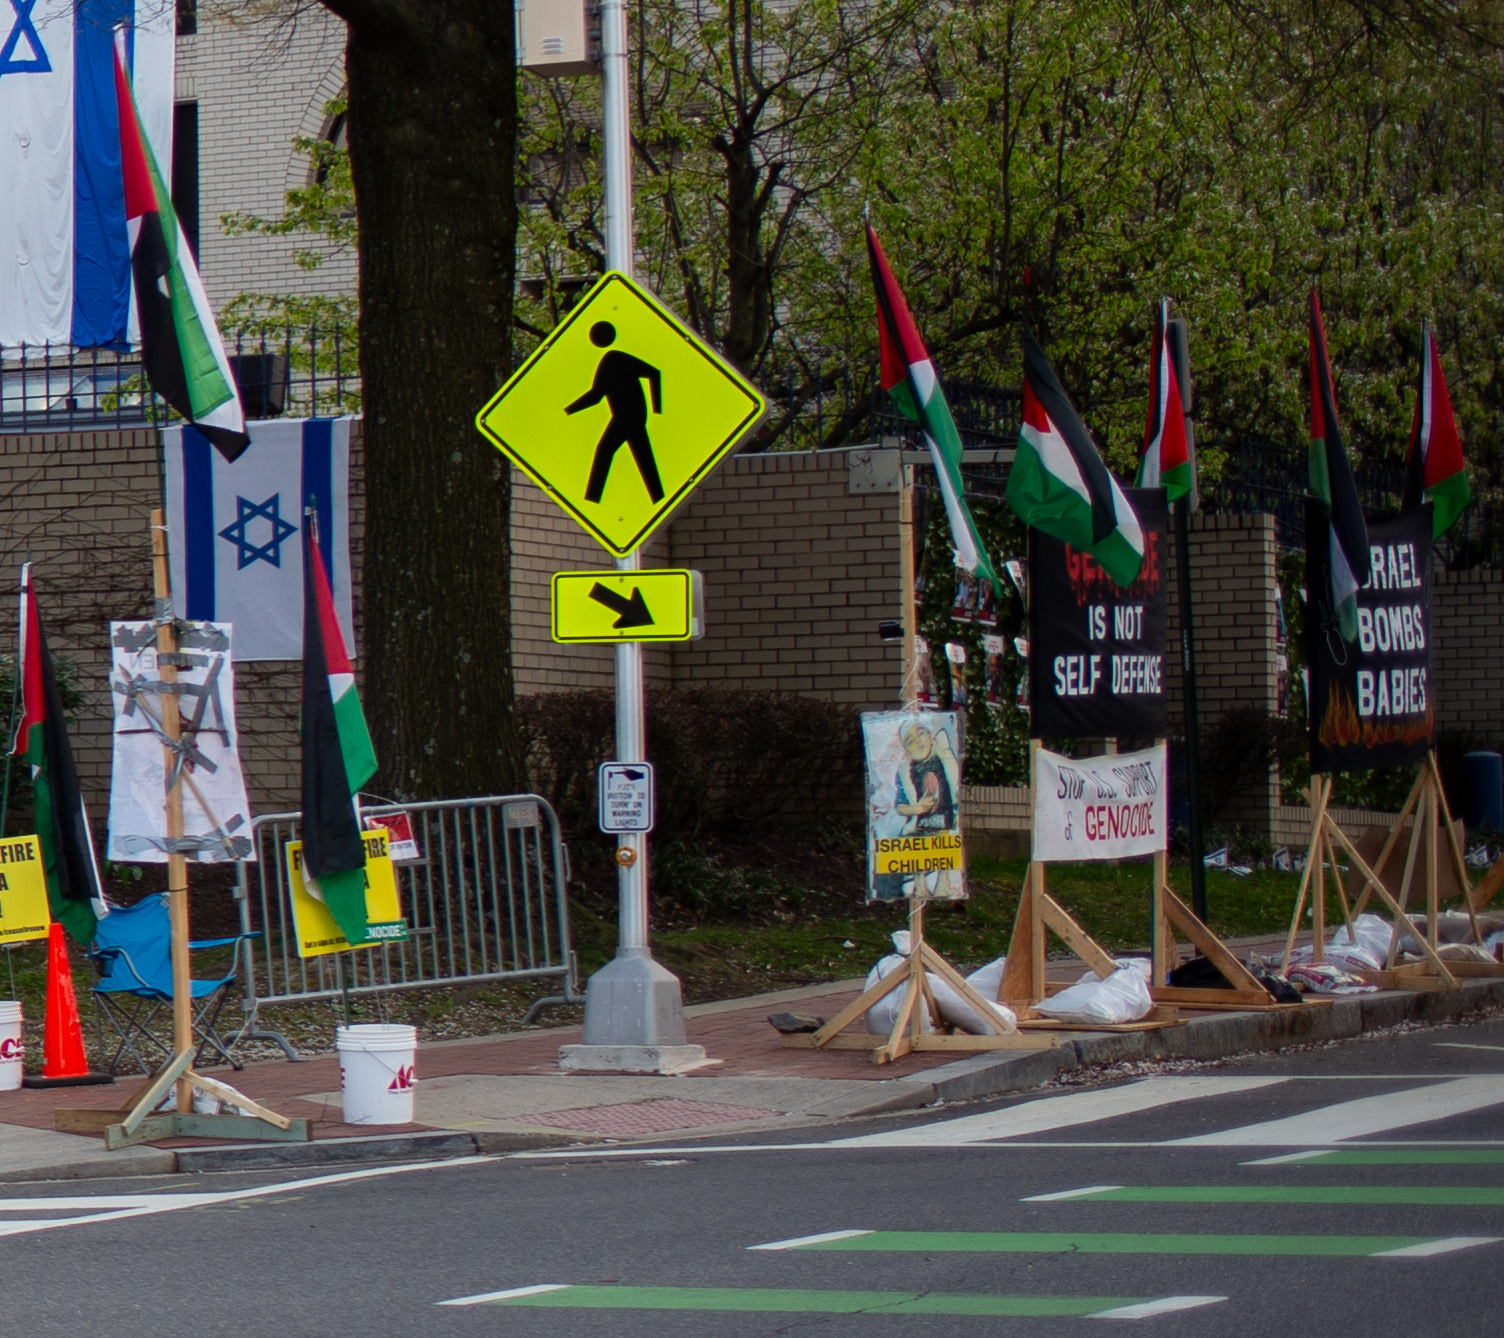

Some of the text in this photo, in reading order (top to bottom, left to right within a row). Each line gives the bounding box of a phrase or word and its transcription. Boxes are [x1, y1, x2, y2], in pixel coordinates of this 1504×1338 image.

[1361, 543, 1421, 590] RAEL
[1089, 605, 1143, 640] IS NOT
[1357, 605, 1425, 652] BOMBS
[1054, 654, 1162, 696] SELF DEFENSE
[1357, 668, 1426, 716] BABIES
[1064, 801, 1155, 841] of GENOCIDE
[876, 834, 961, 853] ISRAEL KILLS
[888, 857, 954, 873] CHILDREN
